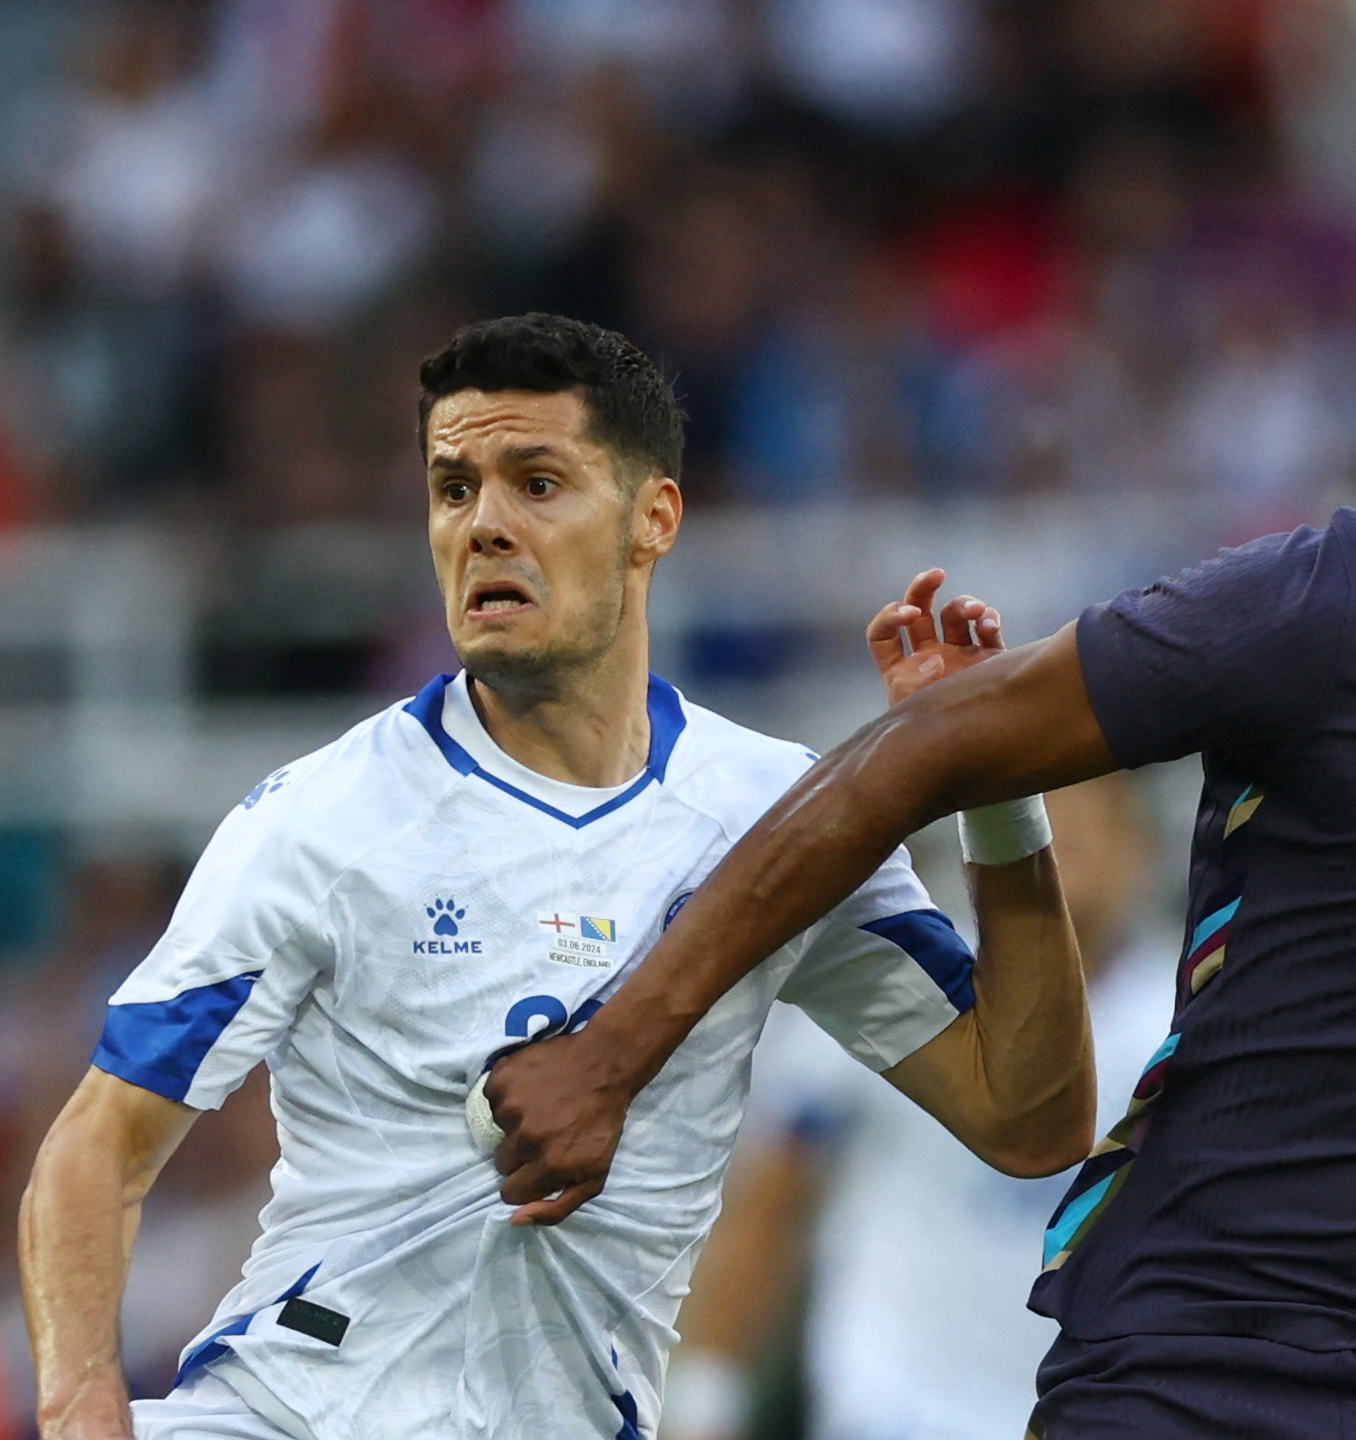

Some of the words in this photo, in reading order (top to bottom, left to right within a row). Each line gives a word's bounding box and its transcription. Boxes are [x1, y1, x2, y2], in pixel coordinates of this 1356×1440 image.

[412, 940, 483, 955] KELME
[557, 938, 602, 955] 03.06.2024
[583, 958, 611, 968] ENGLAND
